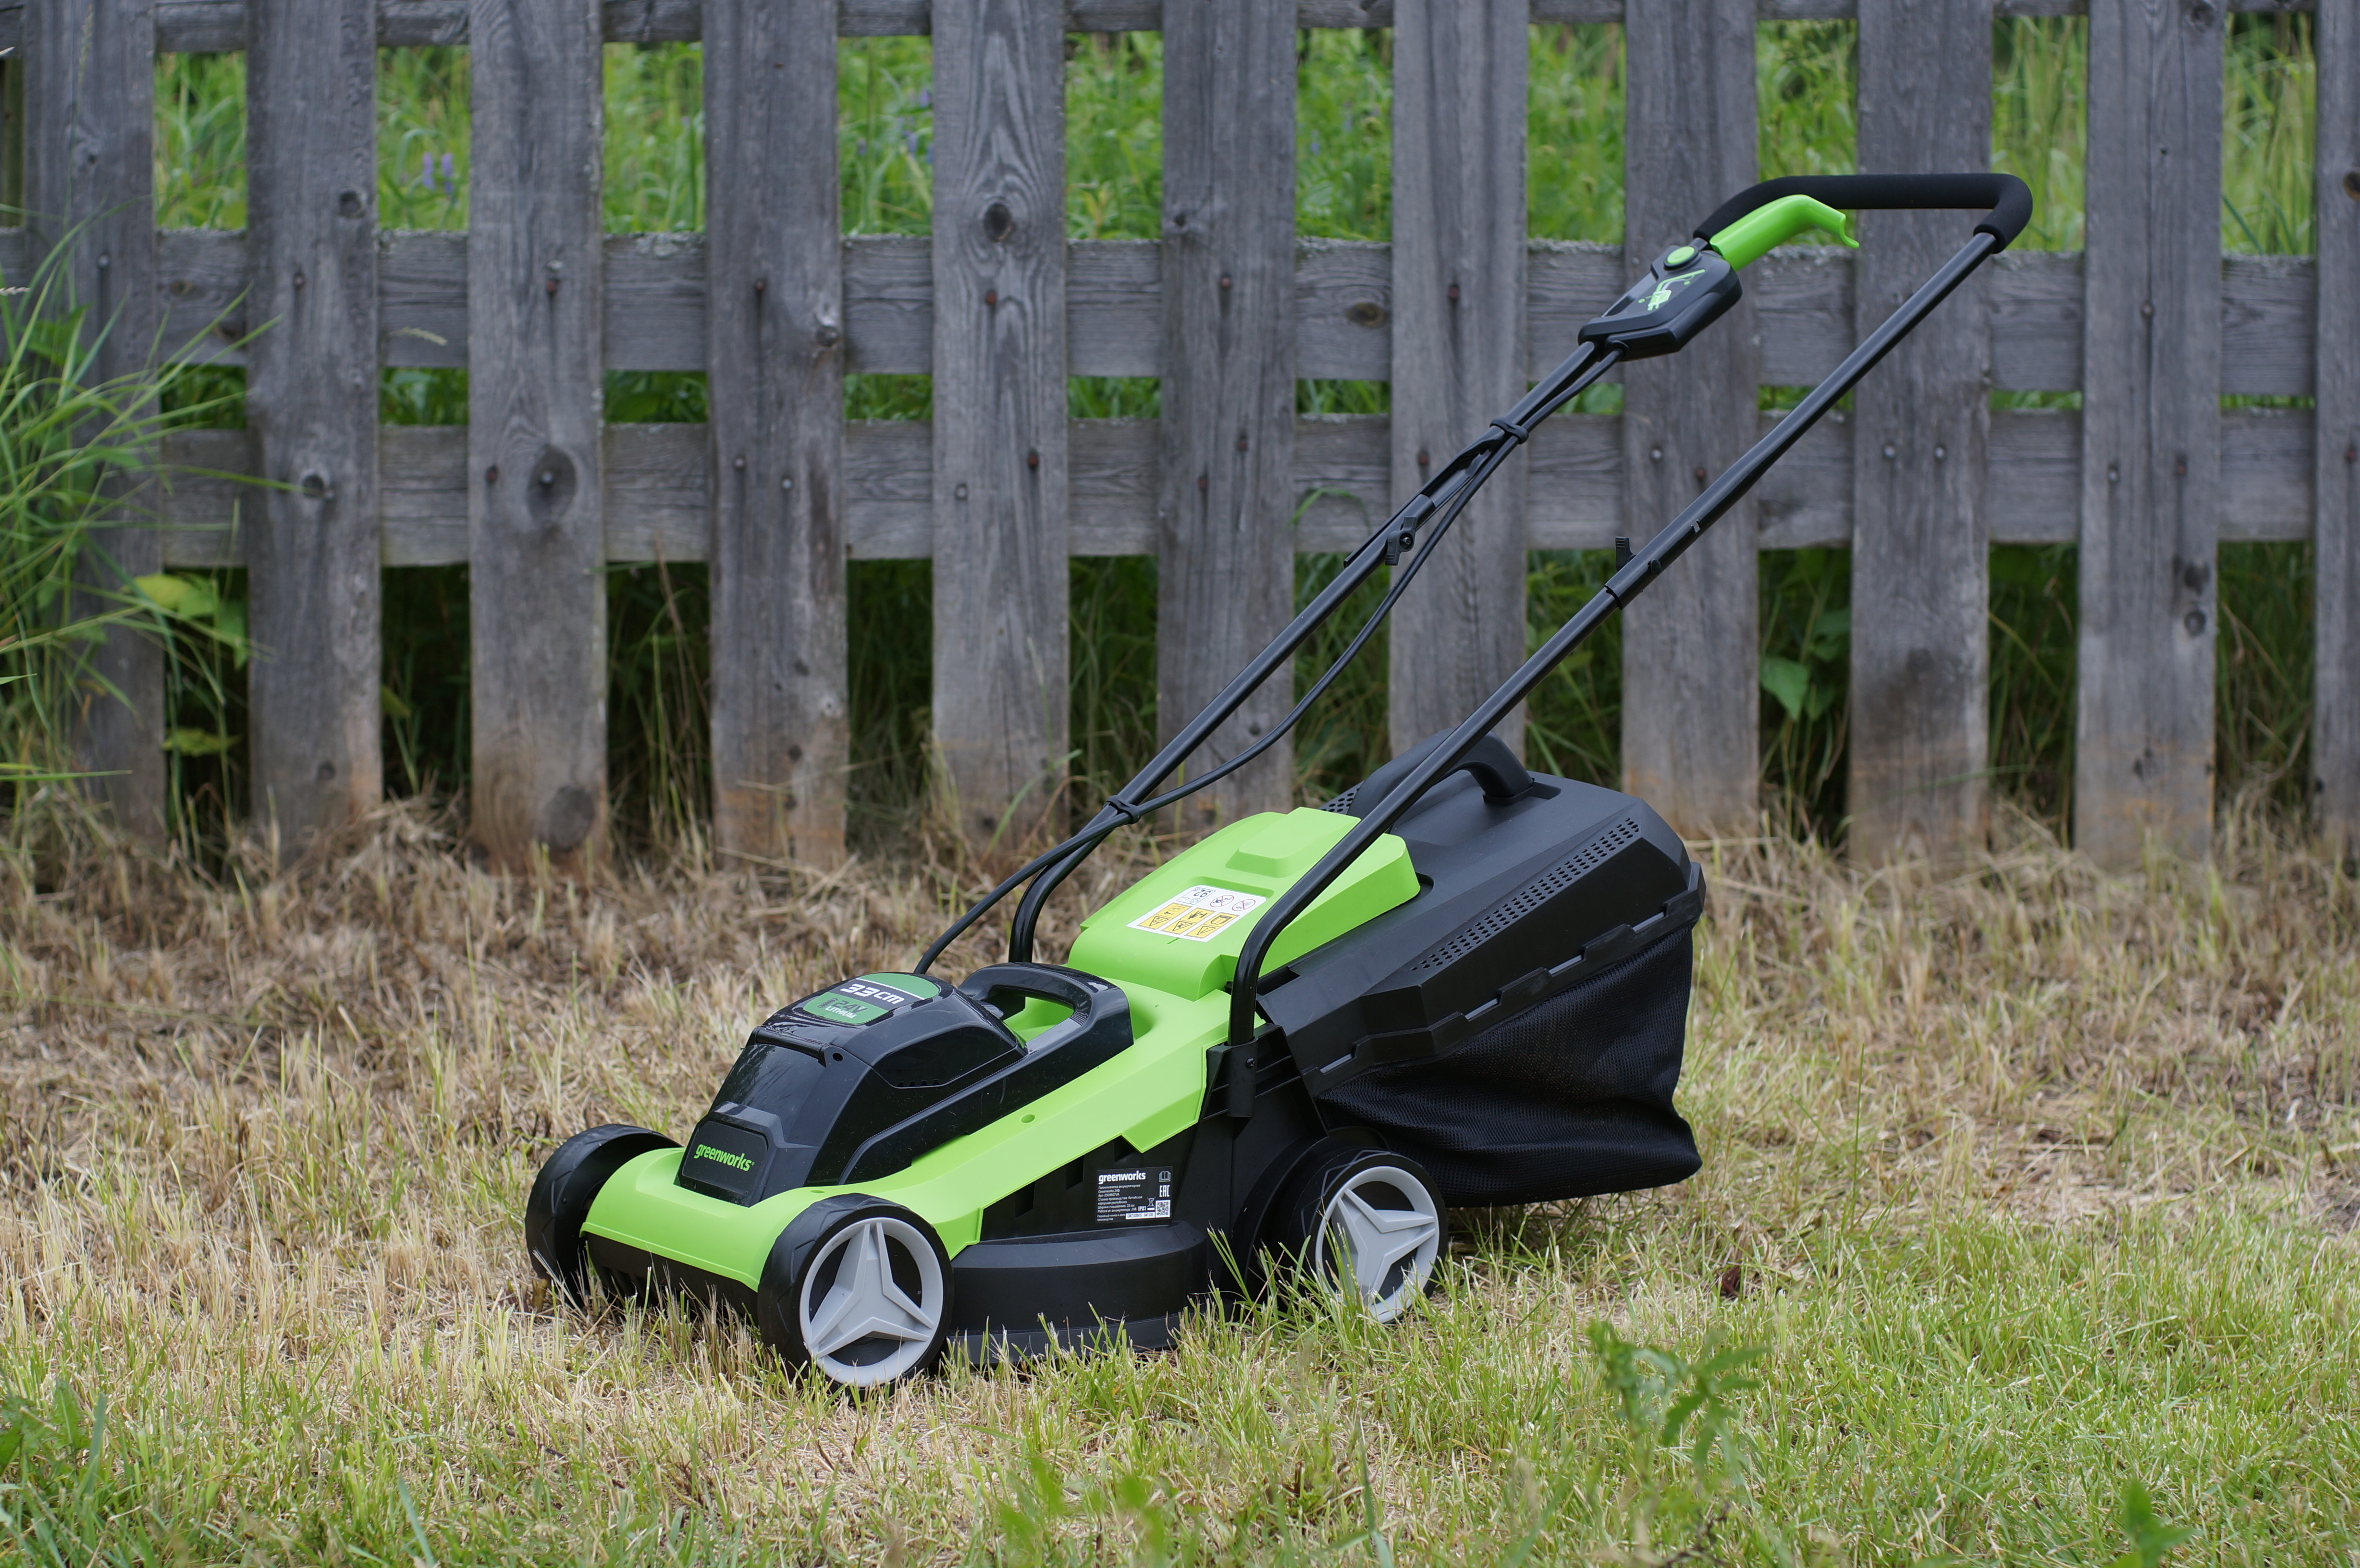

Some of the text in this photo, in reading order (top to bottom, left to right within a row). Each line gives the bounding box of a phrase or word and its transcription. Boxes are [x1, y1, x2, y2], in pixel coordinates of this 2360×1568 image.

[824, 1005, 857, 1019] LITHIUM
[832, 1000, 868, 1014] 24V
[693, 1144, 751, 1171] greenworks
[1098, 1170, 1146, 1185] greenworks
